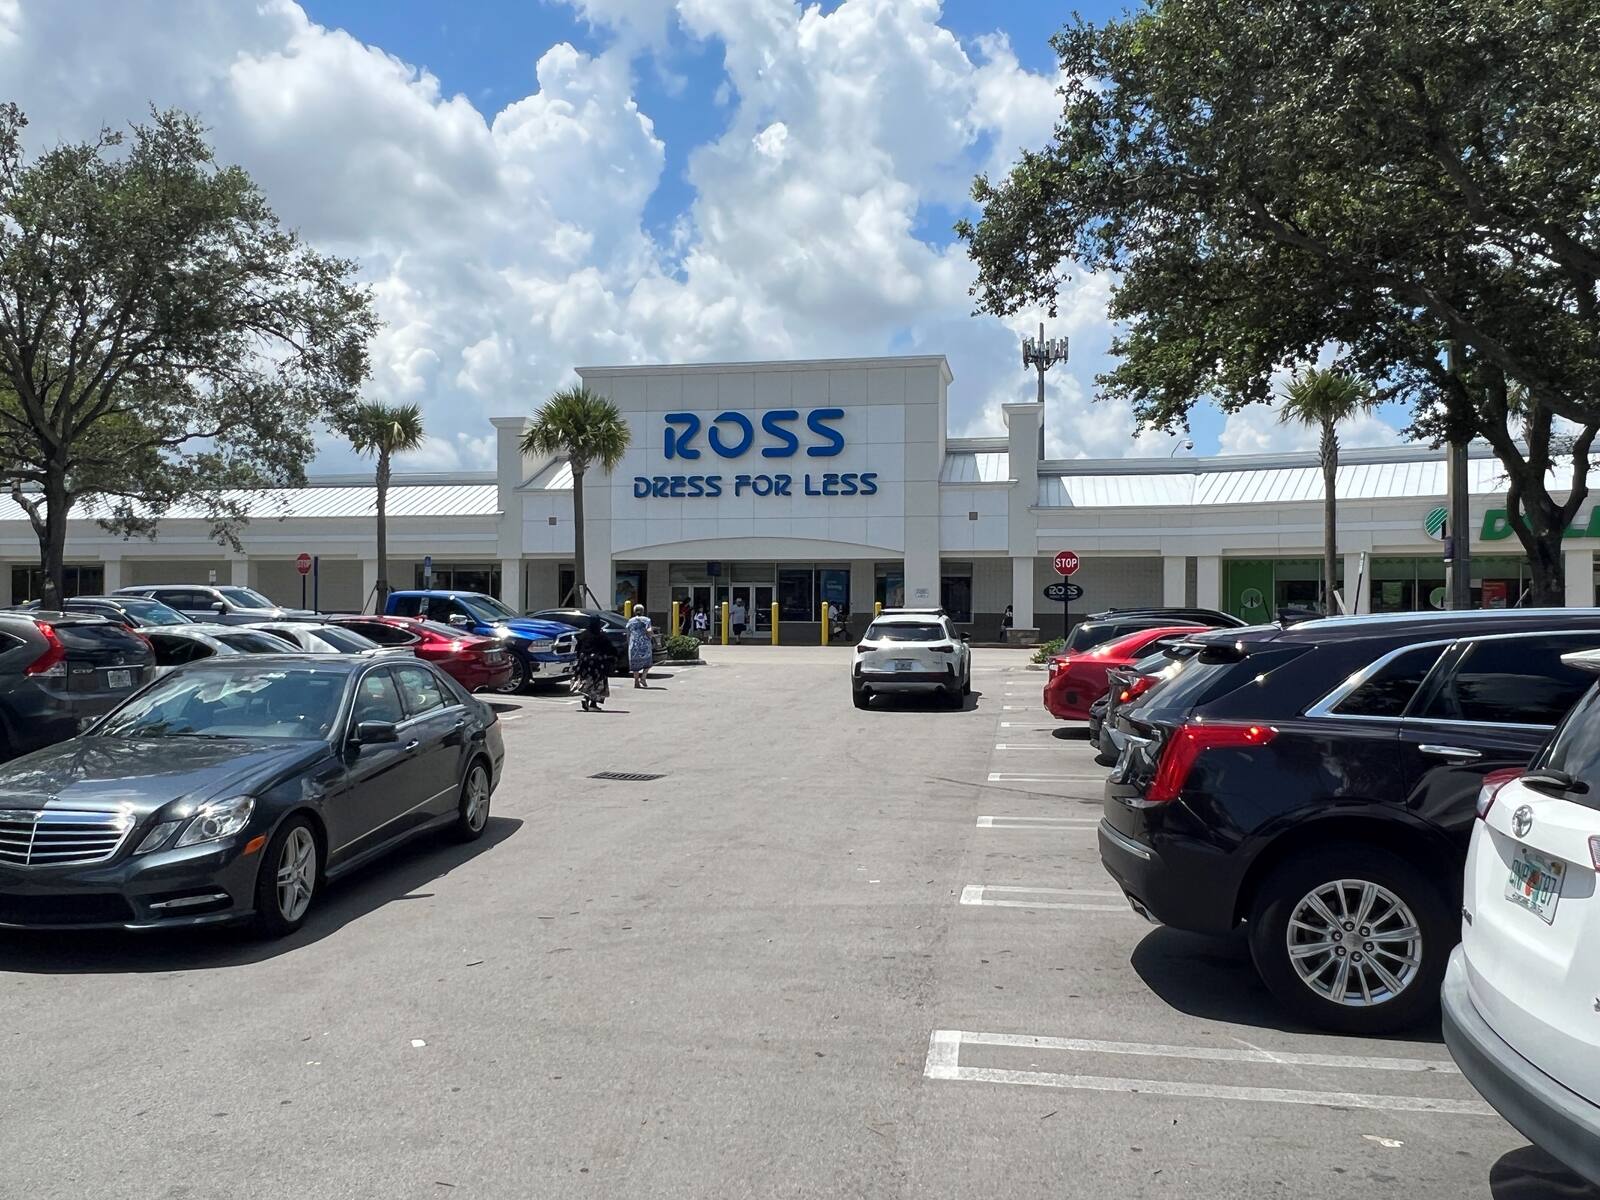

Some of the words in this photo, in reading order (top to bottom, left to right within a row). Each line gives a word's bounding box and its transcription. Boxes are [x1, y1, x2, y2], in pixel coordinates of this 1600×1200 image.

[664, 408, 845, 459] ROSS
[634, 475, 722, 498] DRESS
[735, 474, 792, 497] FOR
[804, 472, 878, 496] LESS
[1055, 558, 1077, 568] STOP
